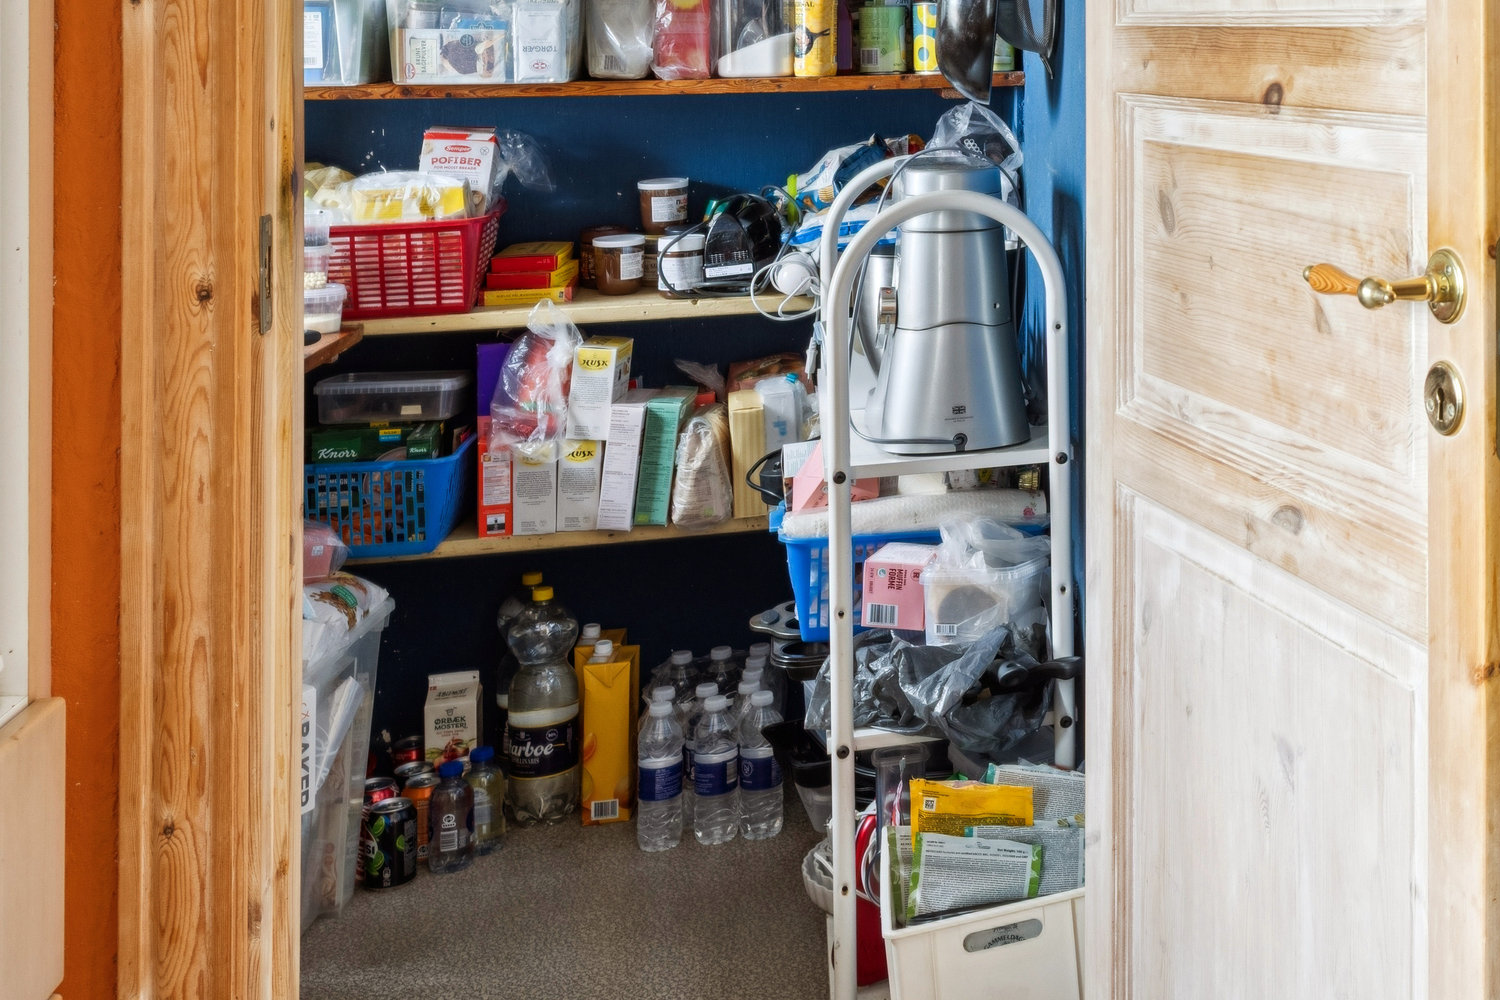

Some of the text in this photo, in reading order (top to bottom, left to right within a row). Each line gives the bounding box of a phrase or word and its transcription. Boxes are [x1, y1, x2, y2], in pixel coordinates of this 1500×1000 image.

[522, 45, 558, 53] TØRGÆR
[431, 156, 482, 166] POFIBER
[318, 448, 357, 459] Knorr
[888, 569, 896, 590] FORME
[434, 716, 466, 725] ØRBÆK
